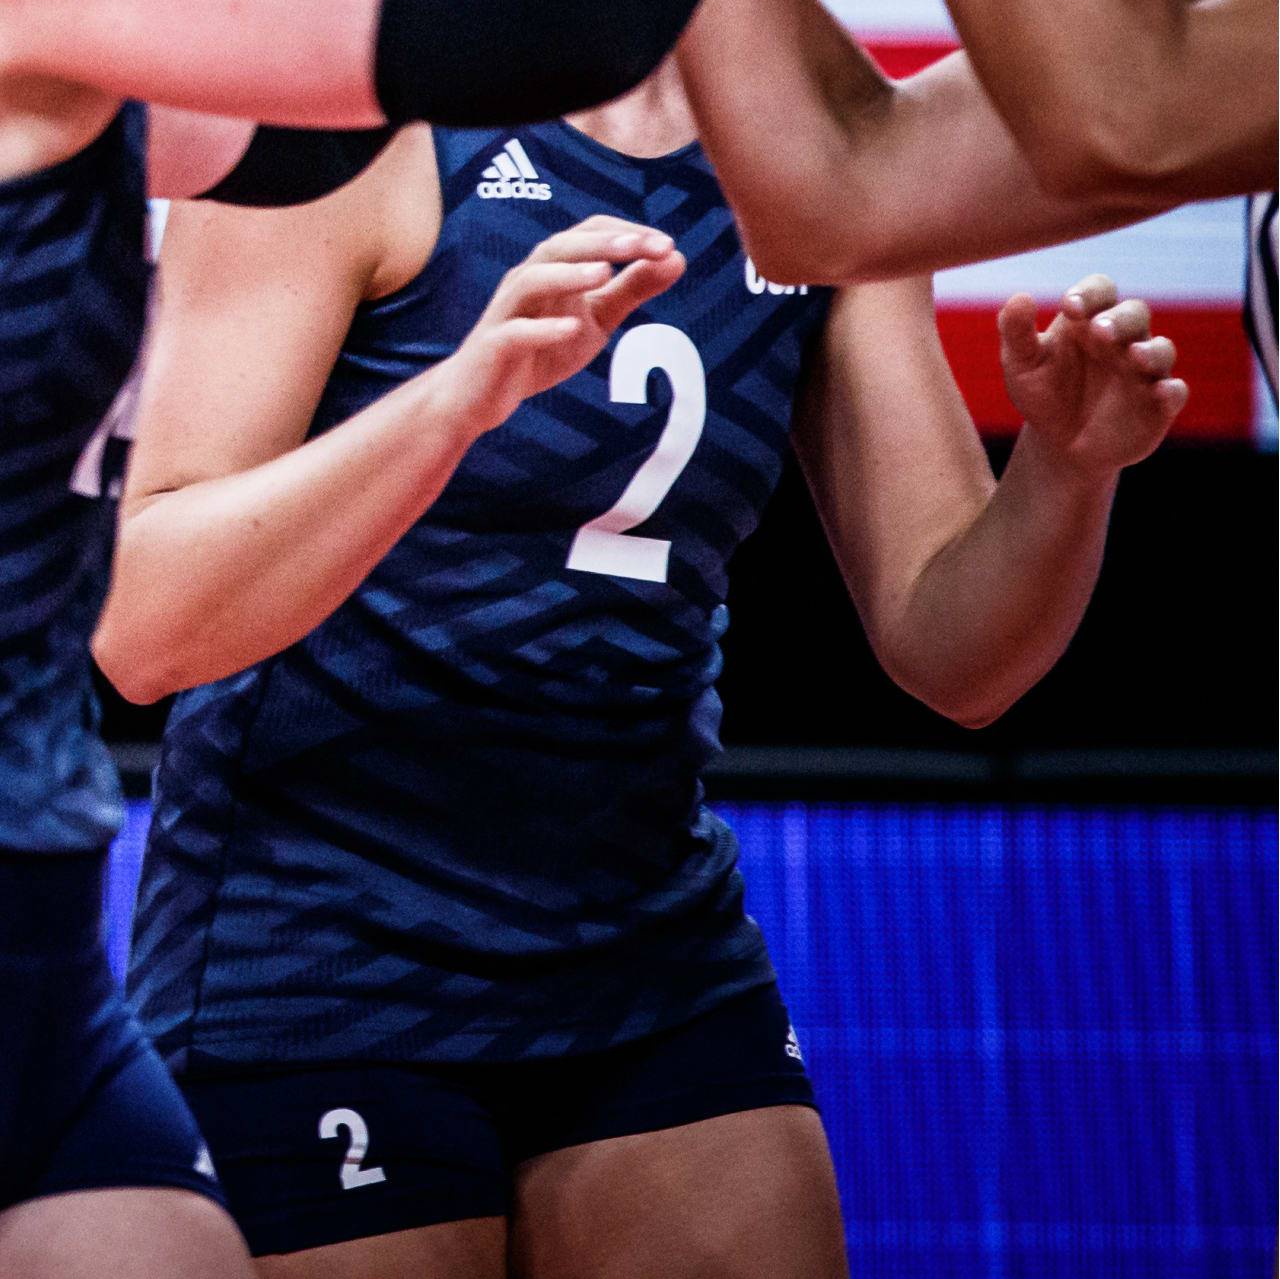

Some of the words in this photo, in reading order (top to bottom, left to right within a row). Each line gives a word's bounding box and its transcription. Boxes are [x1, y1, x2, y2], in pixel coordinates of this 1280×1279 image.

[477, 177, 552, 200] adidas
[566, 323, 707, 583] 2
[318, 1108, 387, 1190] 2
